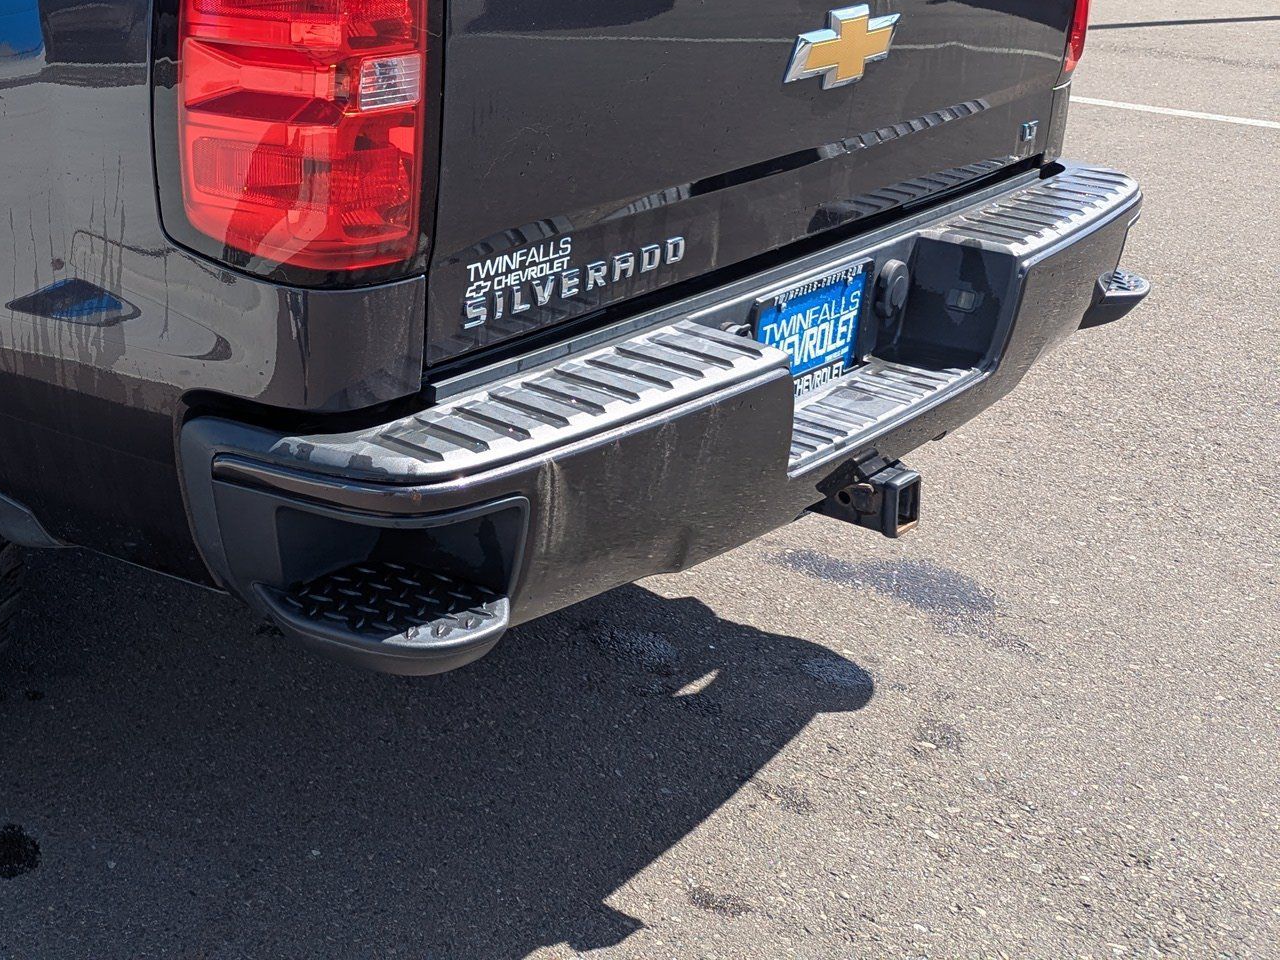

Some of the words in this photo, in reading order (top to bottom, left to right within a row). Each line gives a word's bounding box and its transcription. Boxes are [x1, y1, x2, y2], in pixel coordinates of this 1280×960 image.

[463, 236, 685, 329] SILVERADO
[466, 237, 571, 281] TWINFALLS
[493, 257, 570, 289] CHEVROLET
[763, 290, 861, 345] TWINFALLS
